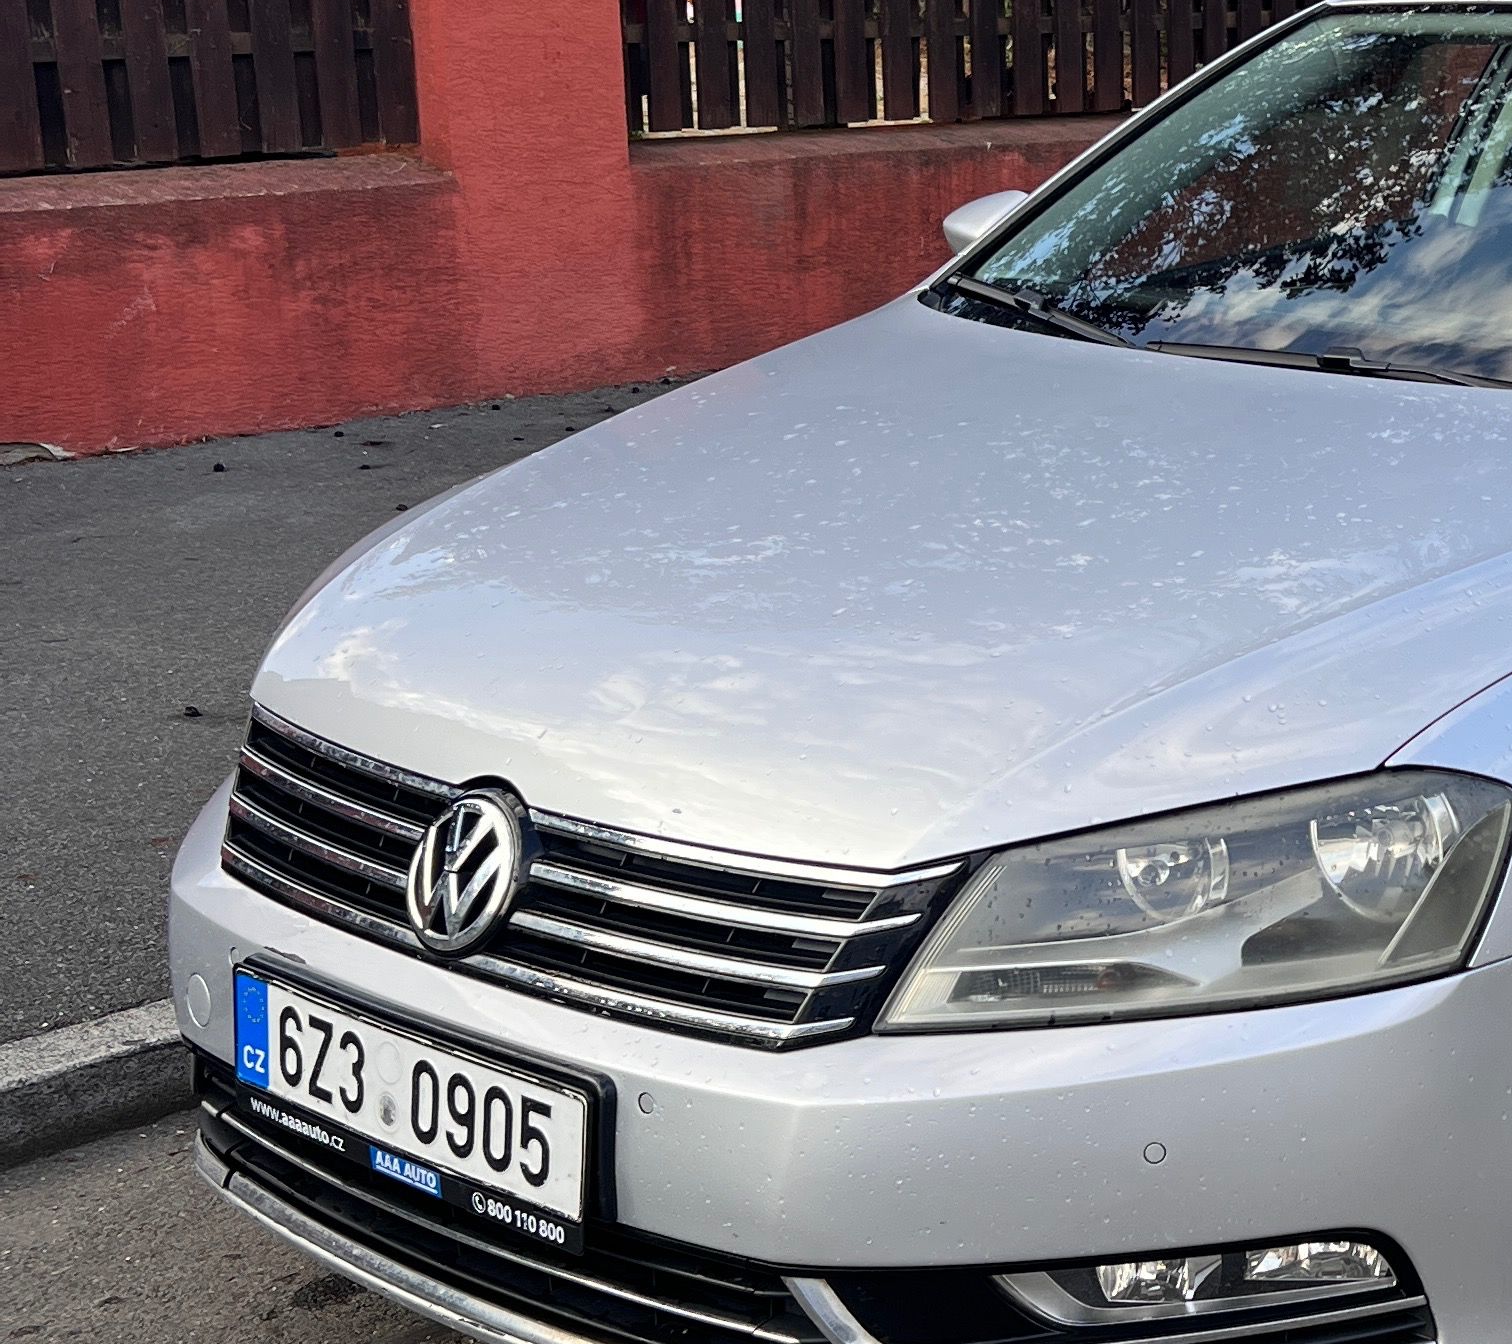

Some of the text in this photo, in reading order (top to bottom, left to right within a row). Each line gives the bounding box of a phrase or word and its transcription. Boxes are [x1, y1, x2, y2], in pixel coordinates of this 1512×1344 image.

[243, 1045, 265, 1074] CZ
[279, 1005, 552, 1187] 6Z3 0905
[250, 1096, 346, 1151] www.aaaauto.cz
[375, 1151, 437, 1188] AAA AUTO
[487, 1198, 565, 1244] 800 110 800
